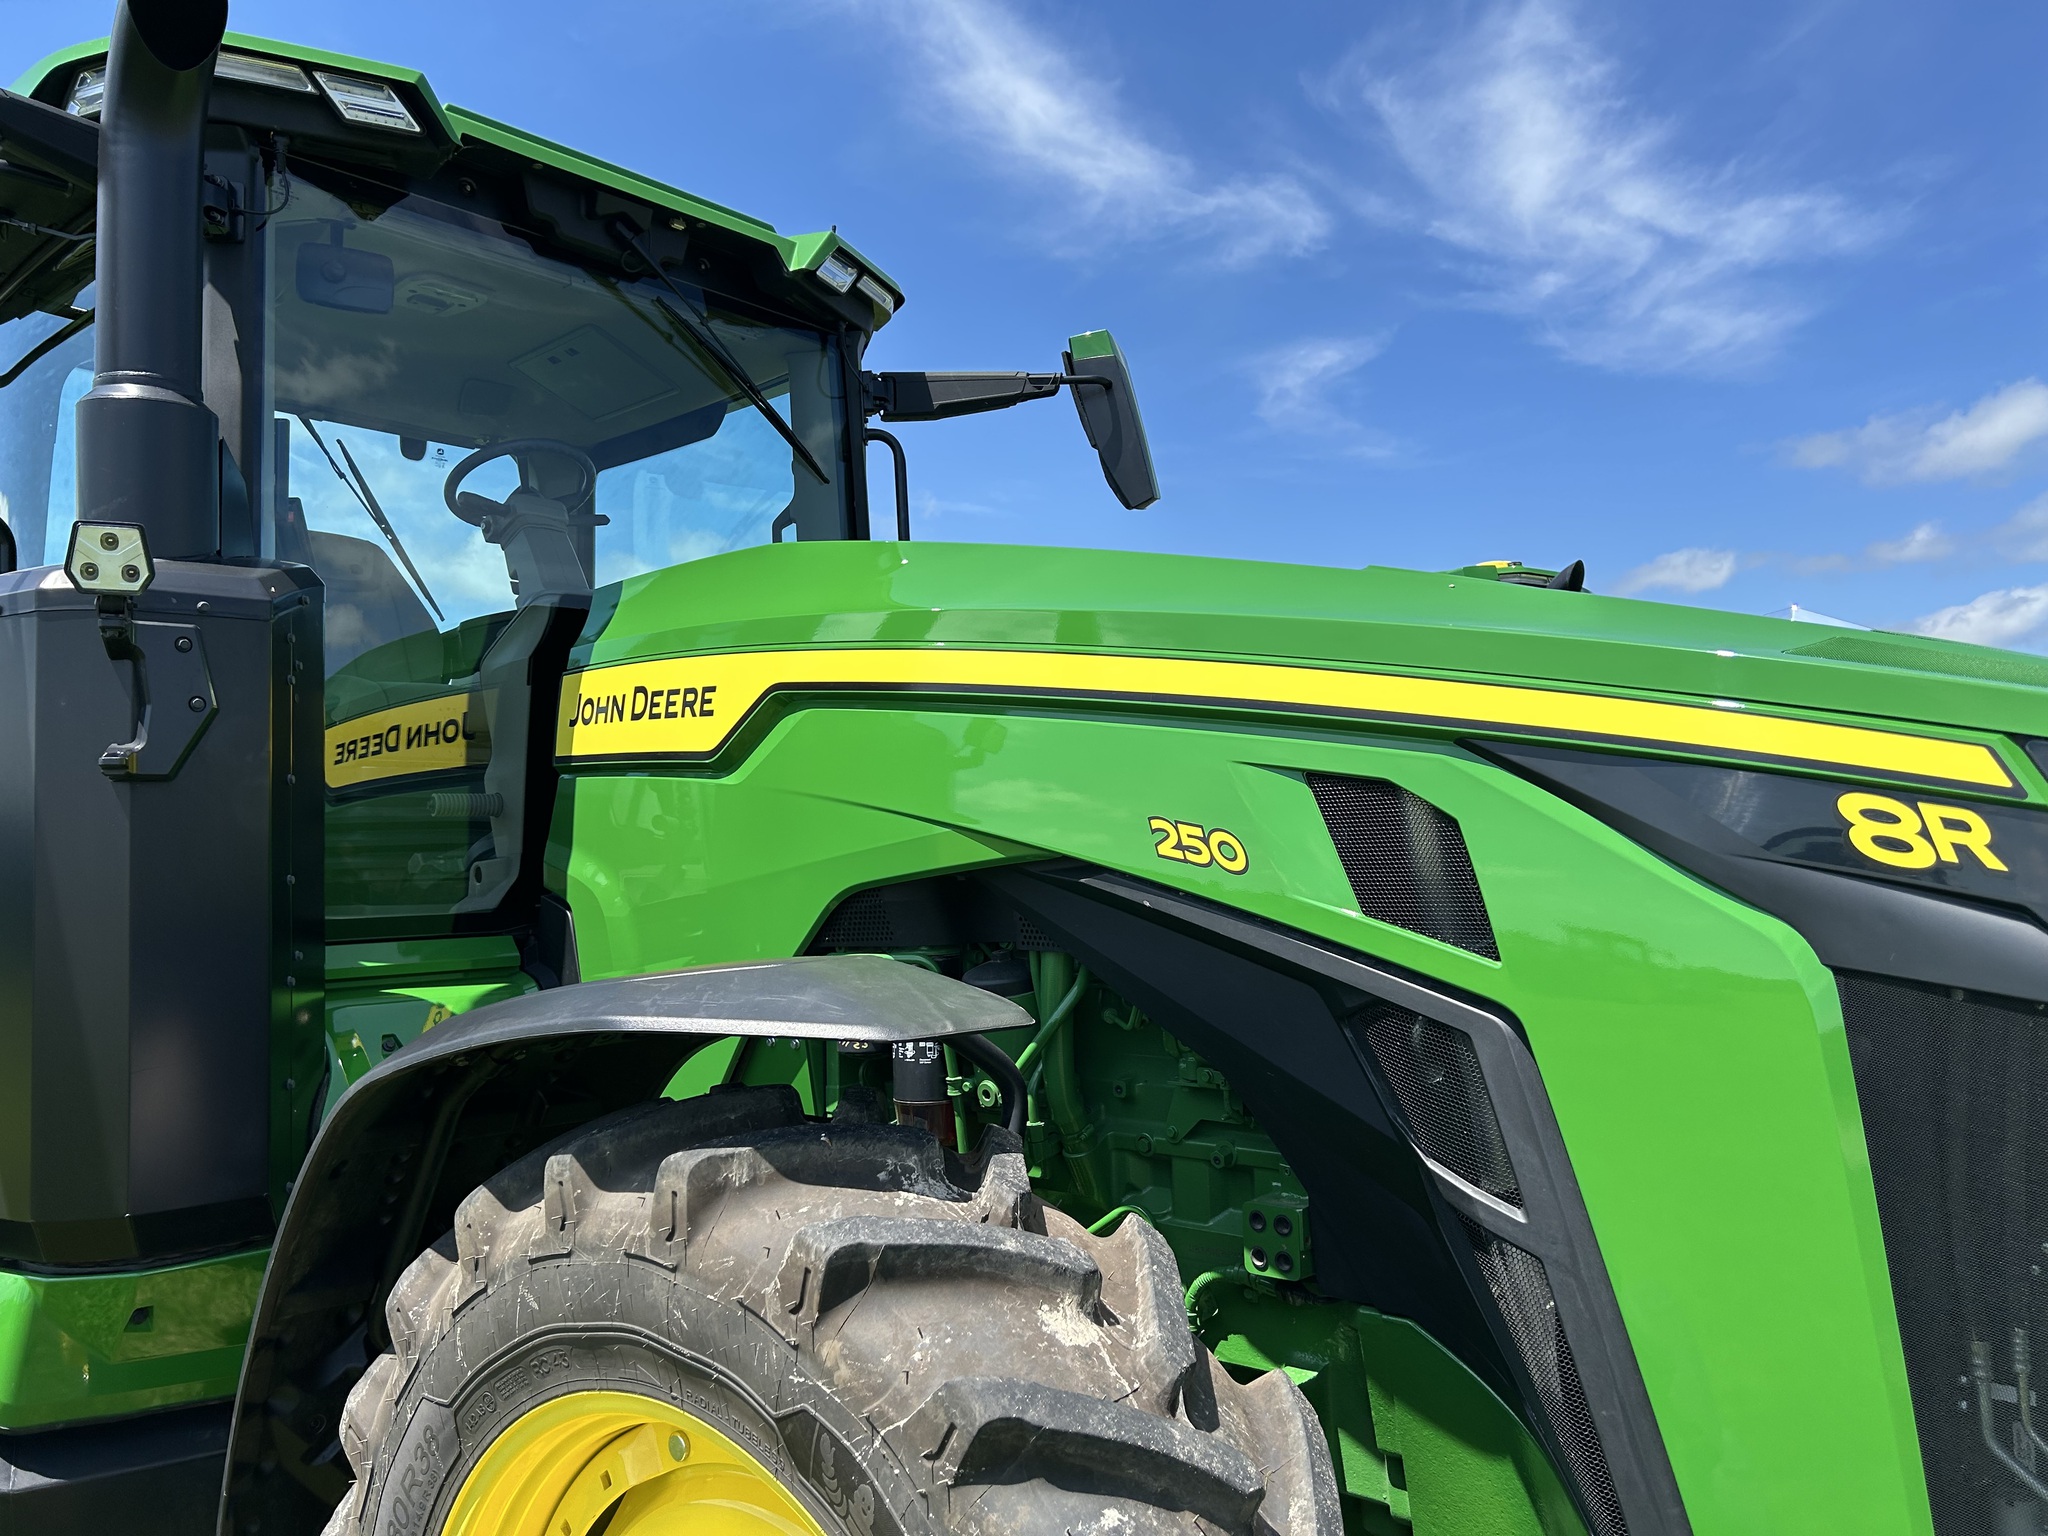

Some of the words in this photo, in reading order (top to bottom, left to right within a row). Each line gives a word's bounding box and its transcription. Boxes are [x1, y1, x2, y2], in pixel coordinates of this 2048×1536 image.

[568, 693, 626, 728] JOHN
[630, 685, 717, 722] DEERE
[1147, 815, 1250, 876] 250
[1836, 791, 2009, 873] 8R
